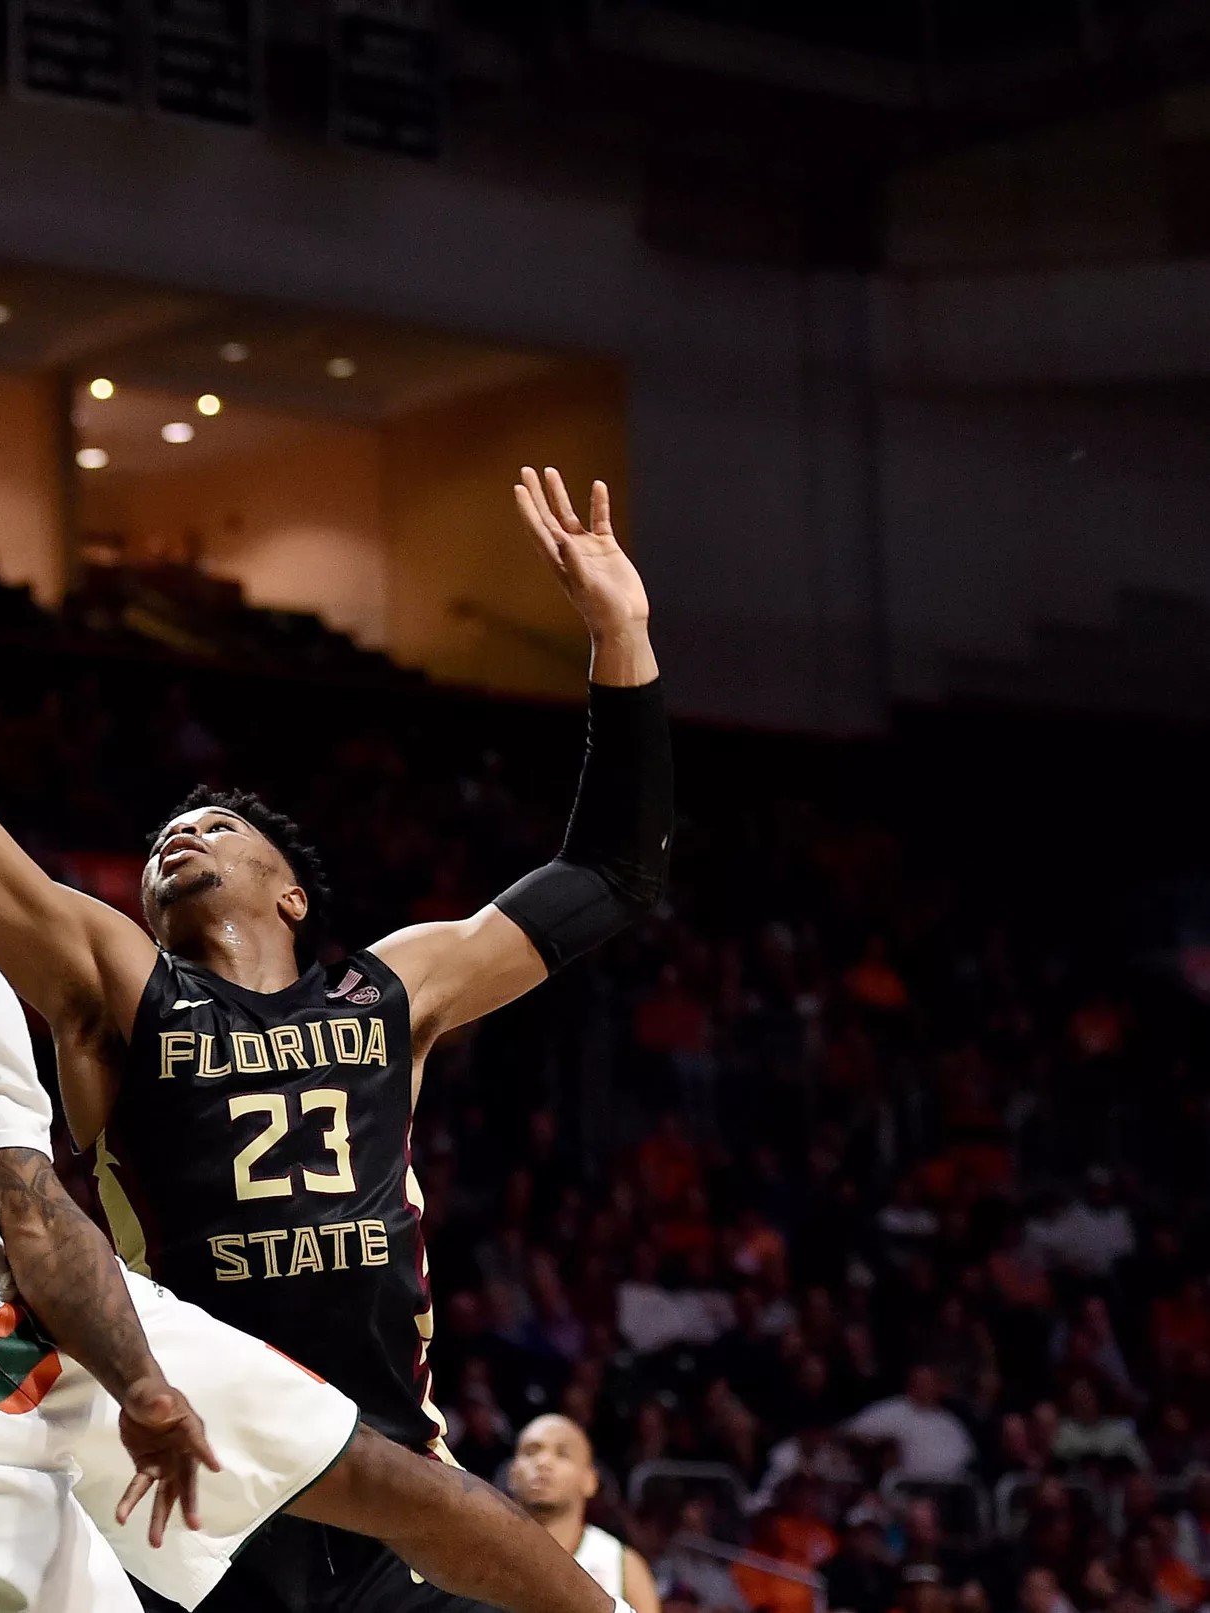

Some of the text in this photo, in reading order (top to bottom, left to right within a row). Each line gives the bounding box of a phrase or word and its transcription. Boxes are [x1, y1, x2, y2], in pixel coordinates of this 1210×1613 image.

[158, 1017, 388, 1079] FLORIDA
[228, 1088, 357, 1201] 23
[207, 1219, 389, 1281] STATE
